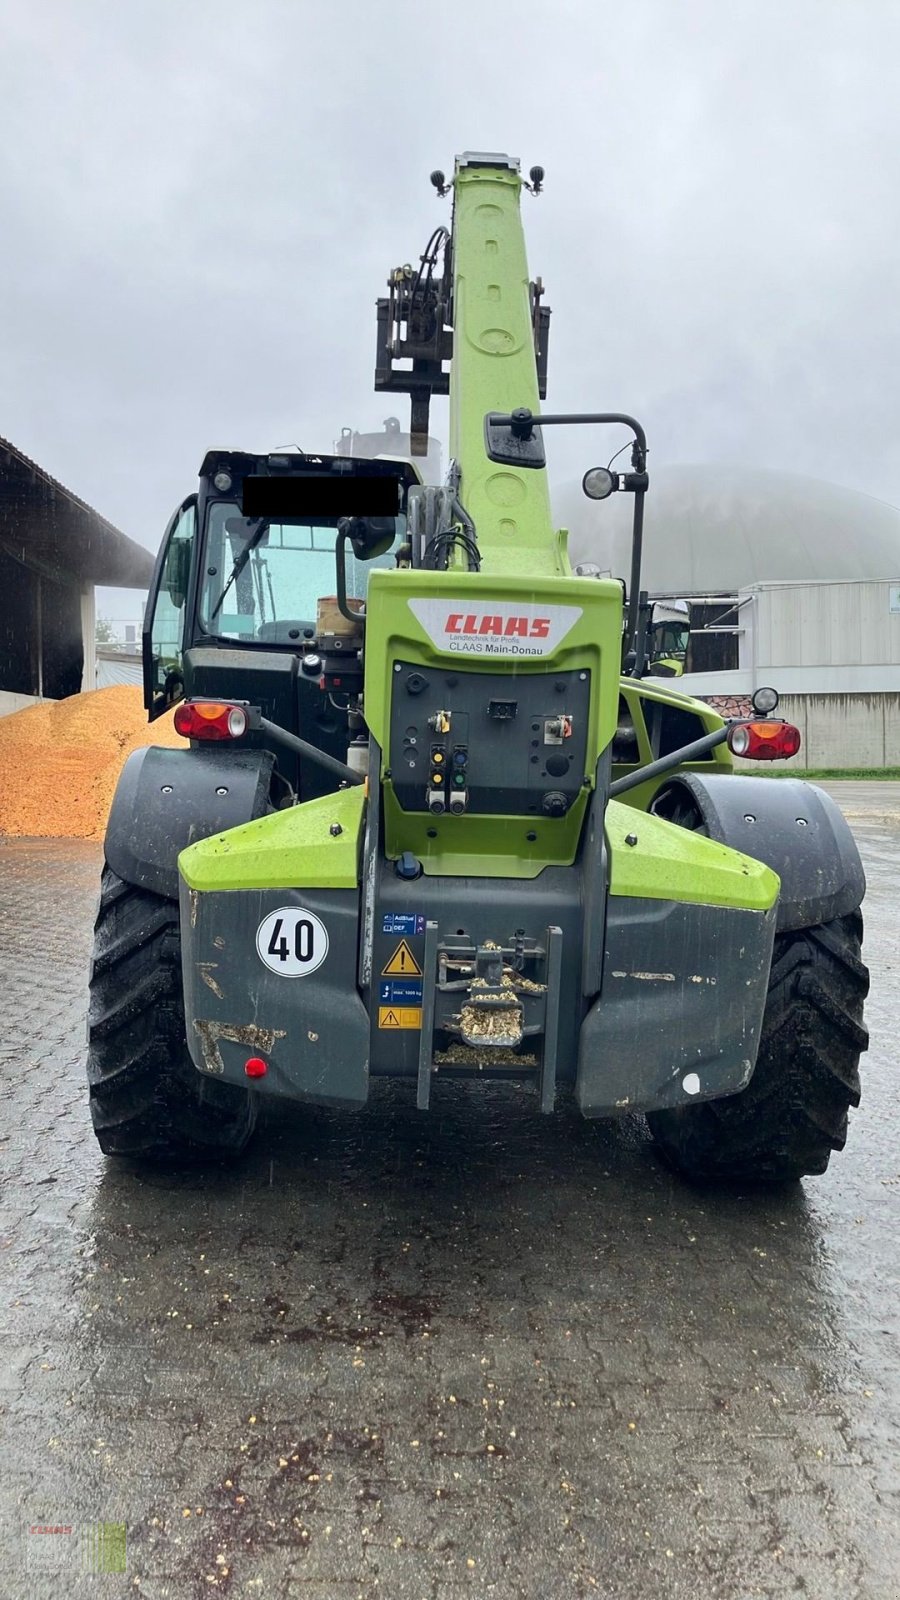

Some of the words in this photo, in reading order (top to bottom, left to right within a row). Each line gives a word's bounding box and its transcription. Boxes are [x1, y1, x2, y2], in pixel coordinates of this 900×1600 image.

[444, 614, 551, 638] CLAAS
[449, 634, 489, 642] Landtechnik
[449, 642, 483, 652] CLAAS
[485, 644, 543, 655] Main-Donau
[268, 919, 314, 963] 40
